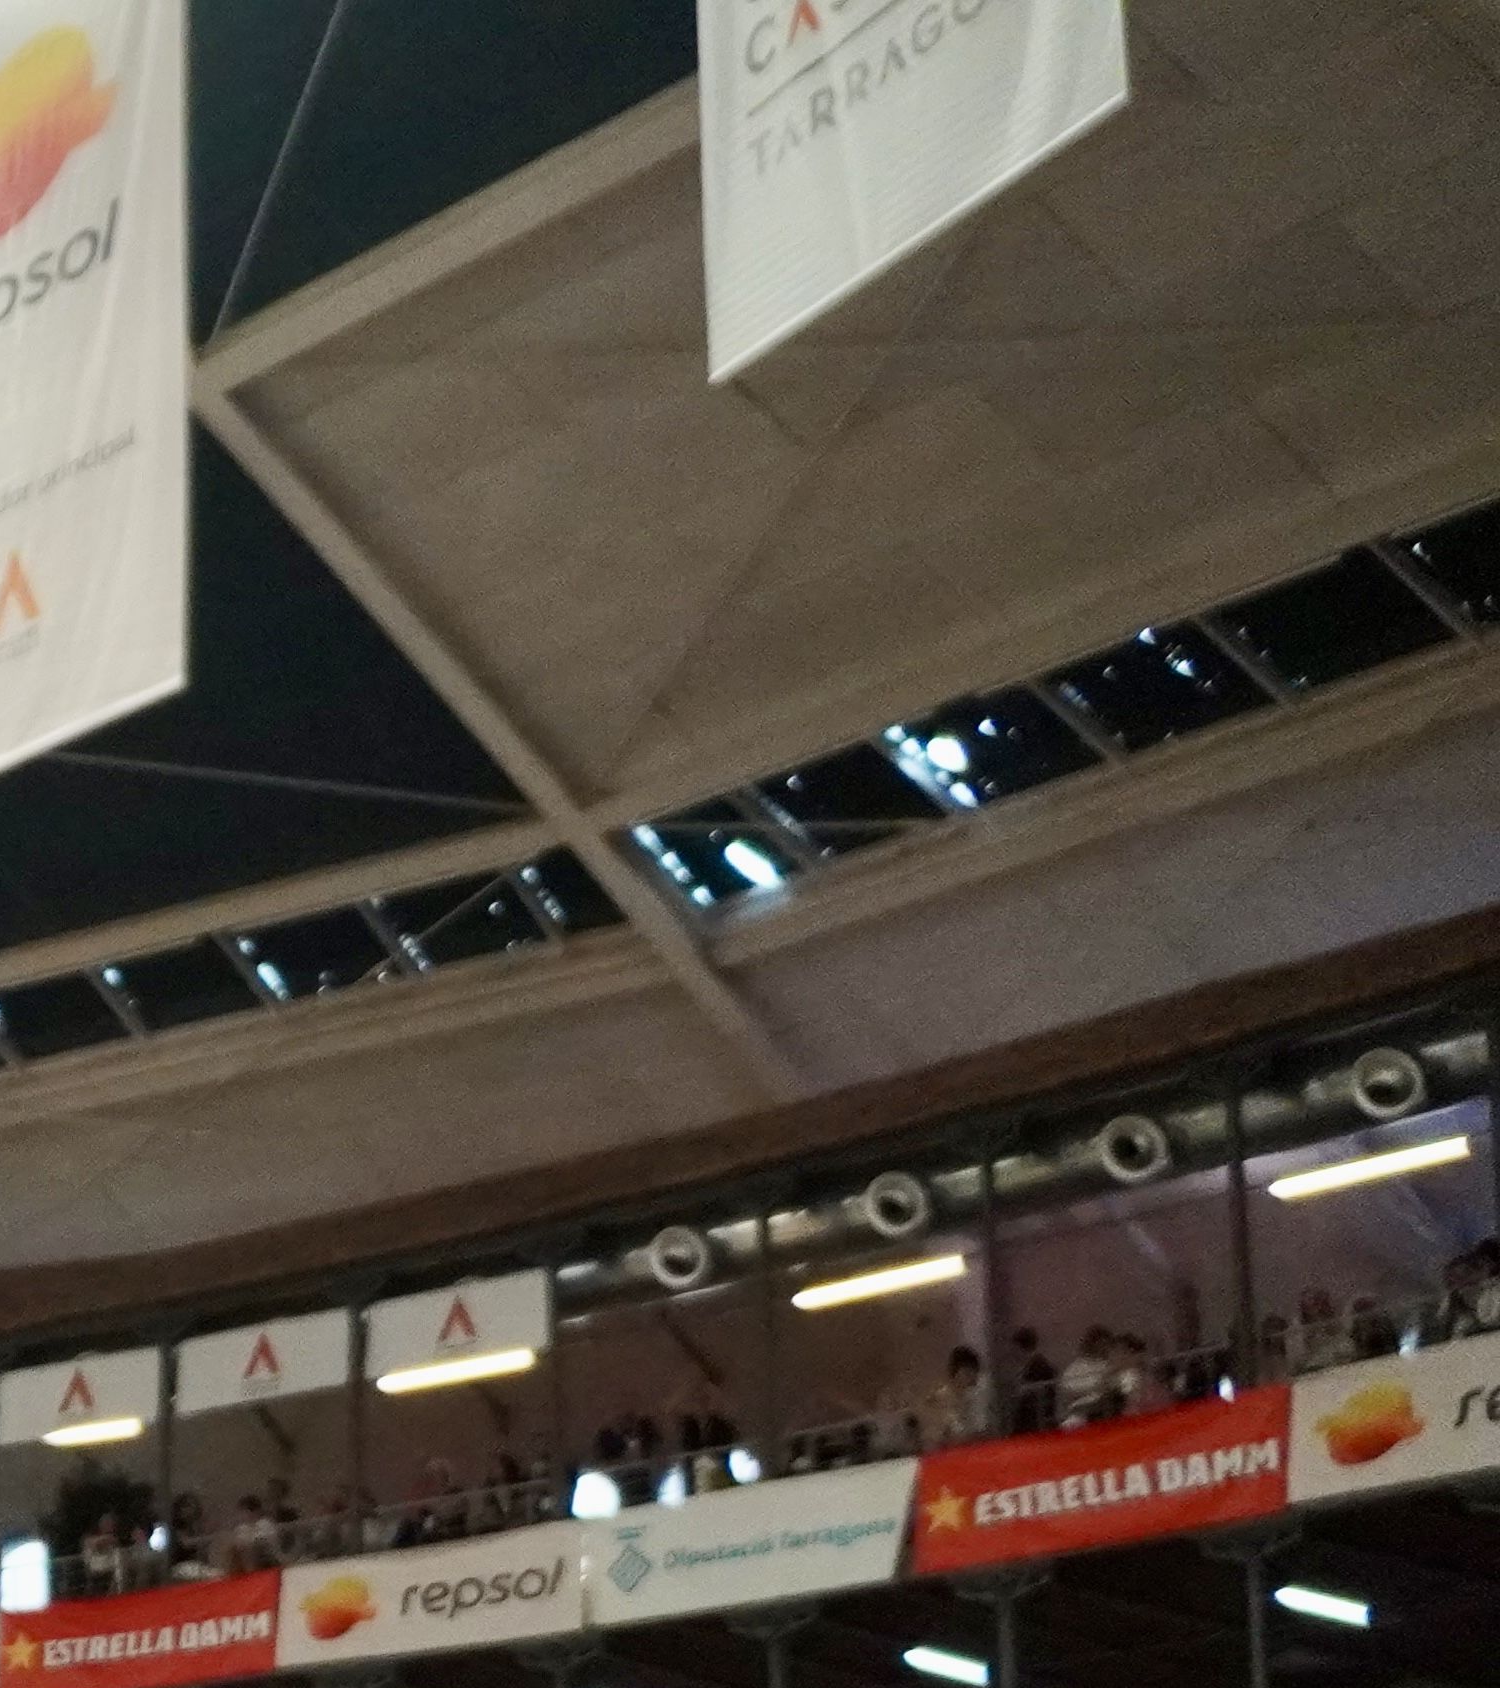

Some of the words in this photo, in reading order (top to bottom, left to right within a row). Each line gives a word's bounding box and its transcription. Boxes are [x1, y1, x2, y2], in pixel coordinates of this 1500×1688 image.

[974, 1462, 1150, 1526] ESTRELLA
[1157, 1437, 1280, 1494] DAMM
[398, 1555, 566, 1618] repsol
[42, 1623, 176, 1668] ESTRELLA
[179, 1610, 270, 1652] DAMM
